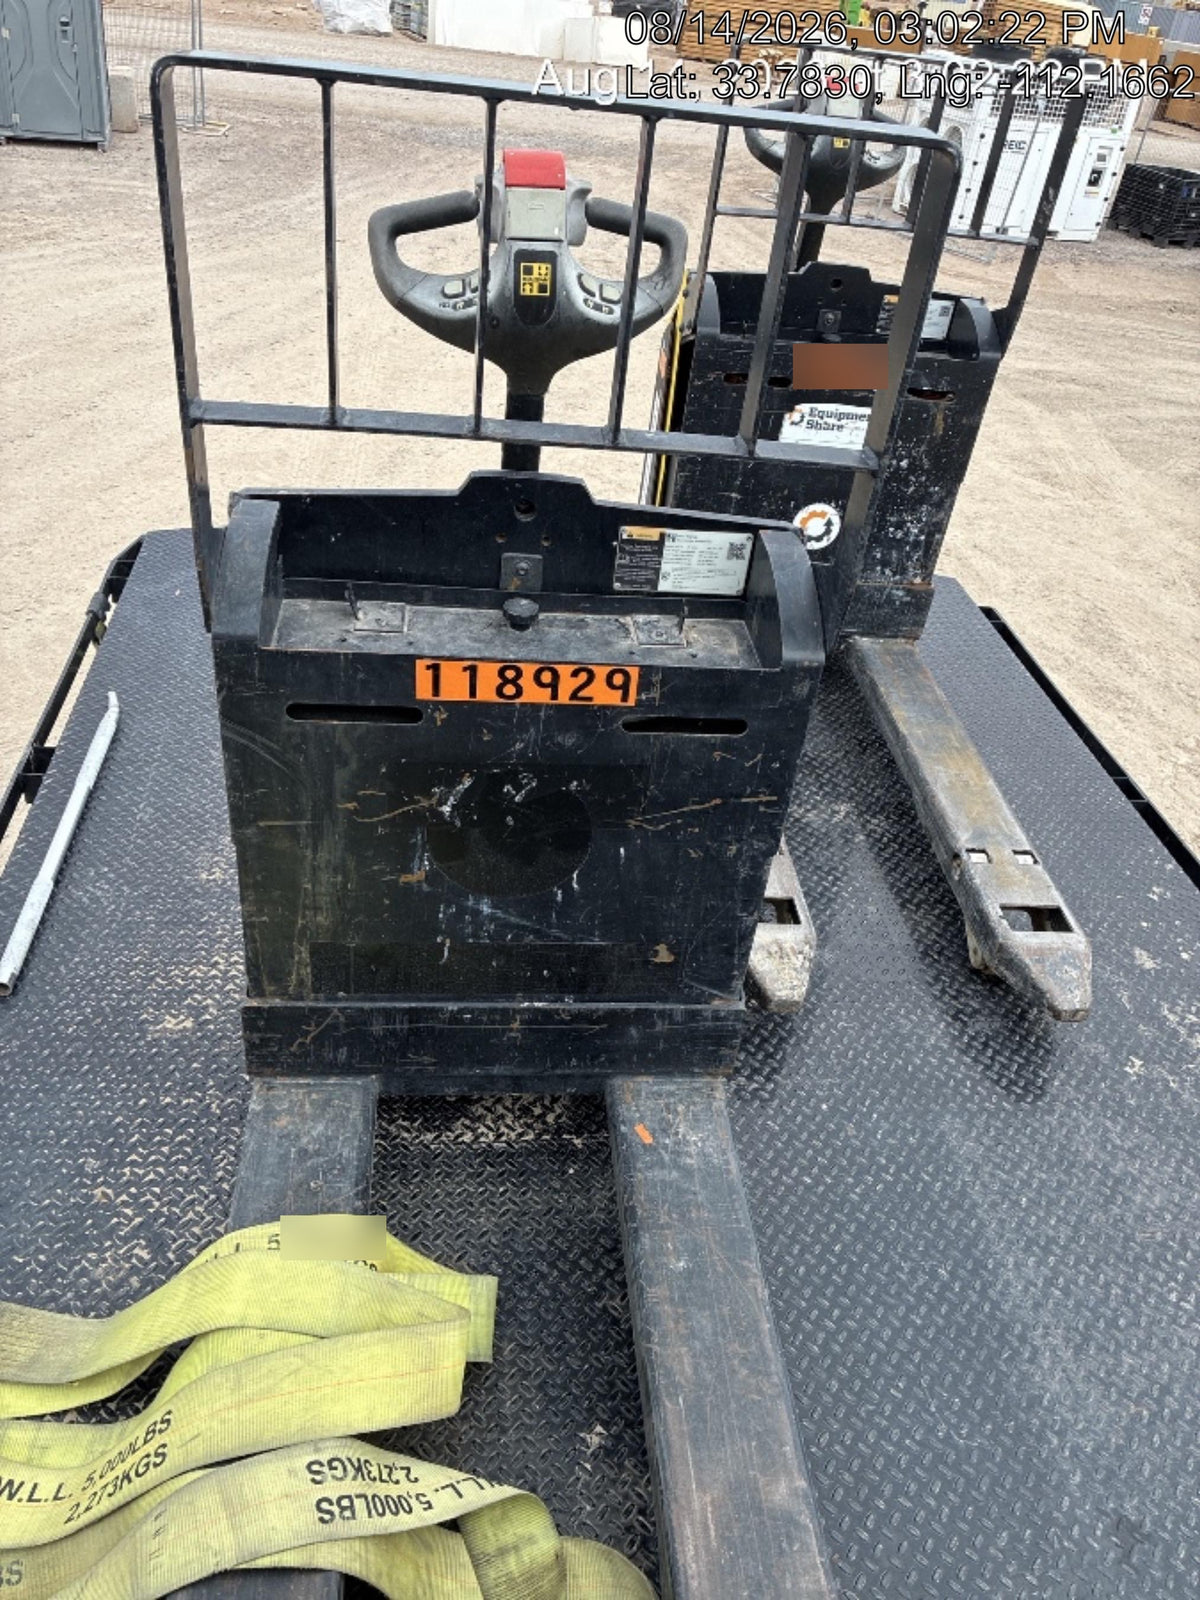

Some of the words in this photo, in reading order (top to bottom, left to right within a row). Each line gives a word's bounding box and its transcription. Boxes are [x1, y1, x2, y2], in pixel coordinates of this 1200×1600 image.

[805, 419, 844, 432] Share
[424, 662, 632, 703] 118929
[0, 1475, 73, 1503] W.L.L.
[81, 1409, 173, 1492] 5,000LBS
[305, 1456, 420, 1485] 2,273KGS
[64, 1443, 168, 1525] 2,273KGS
[315, 1490, 434, 1524] 5,000LBS
